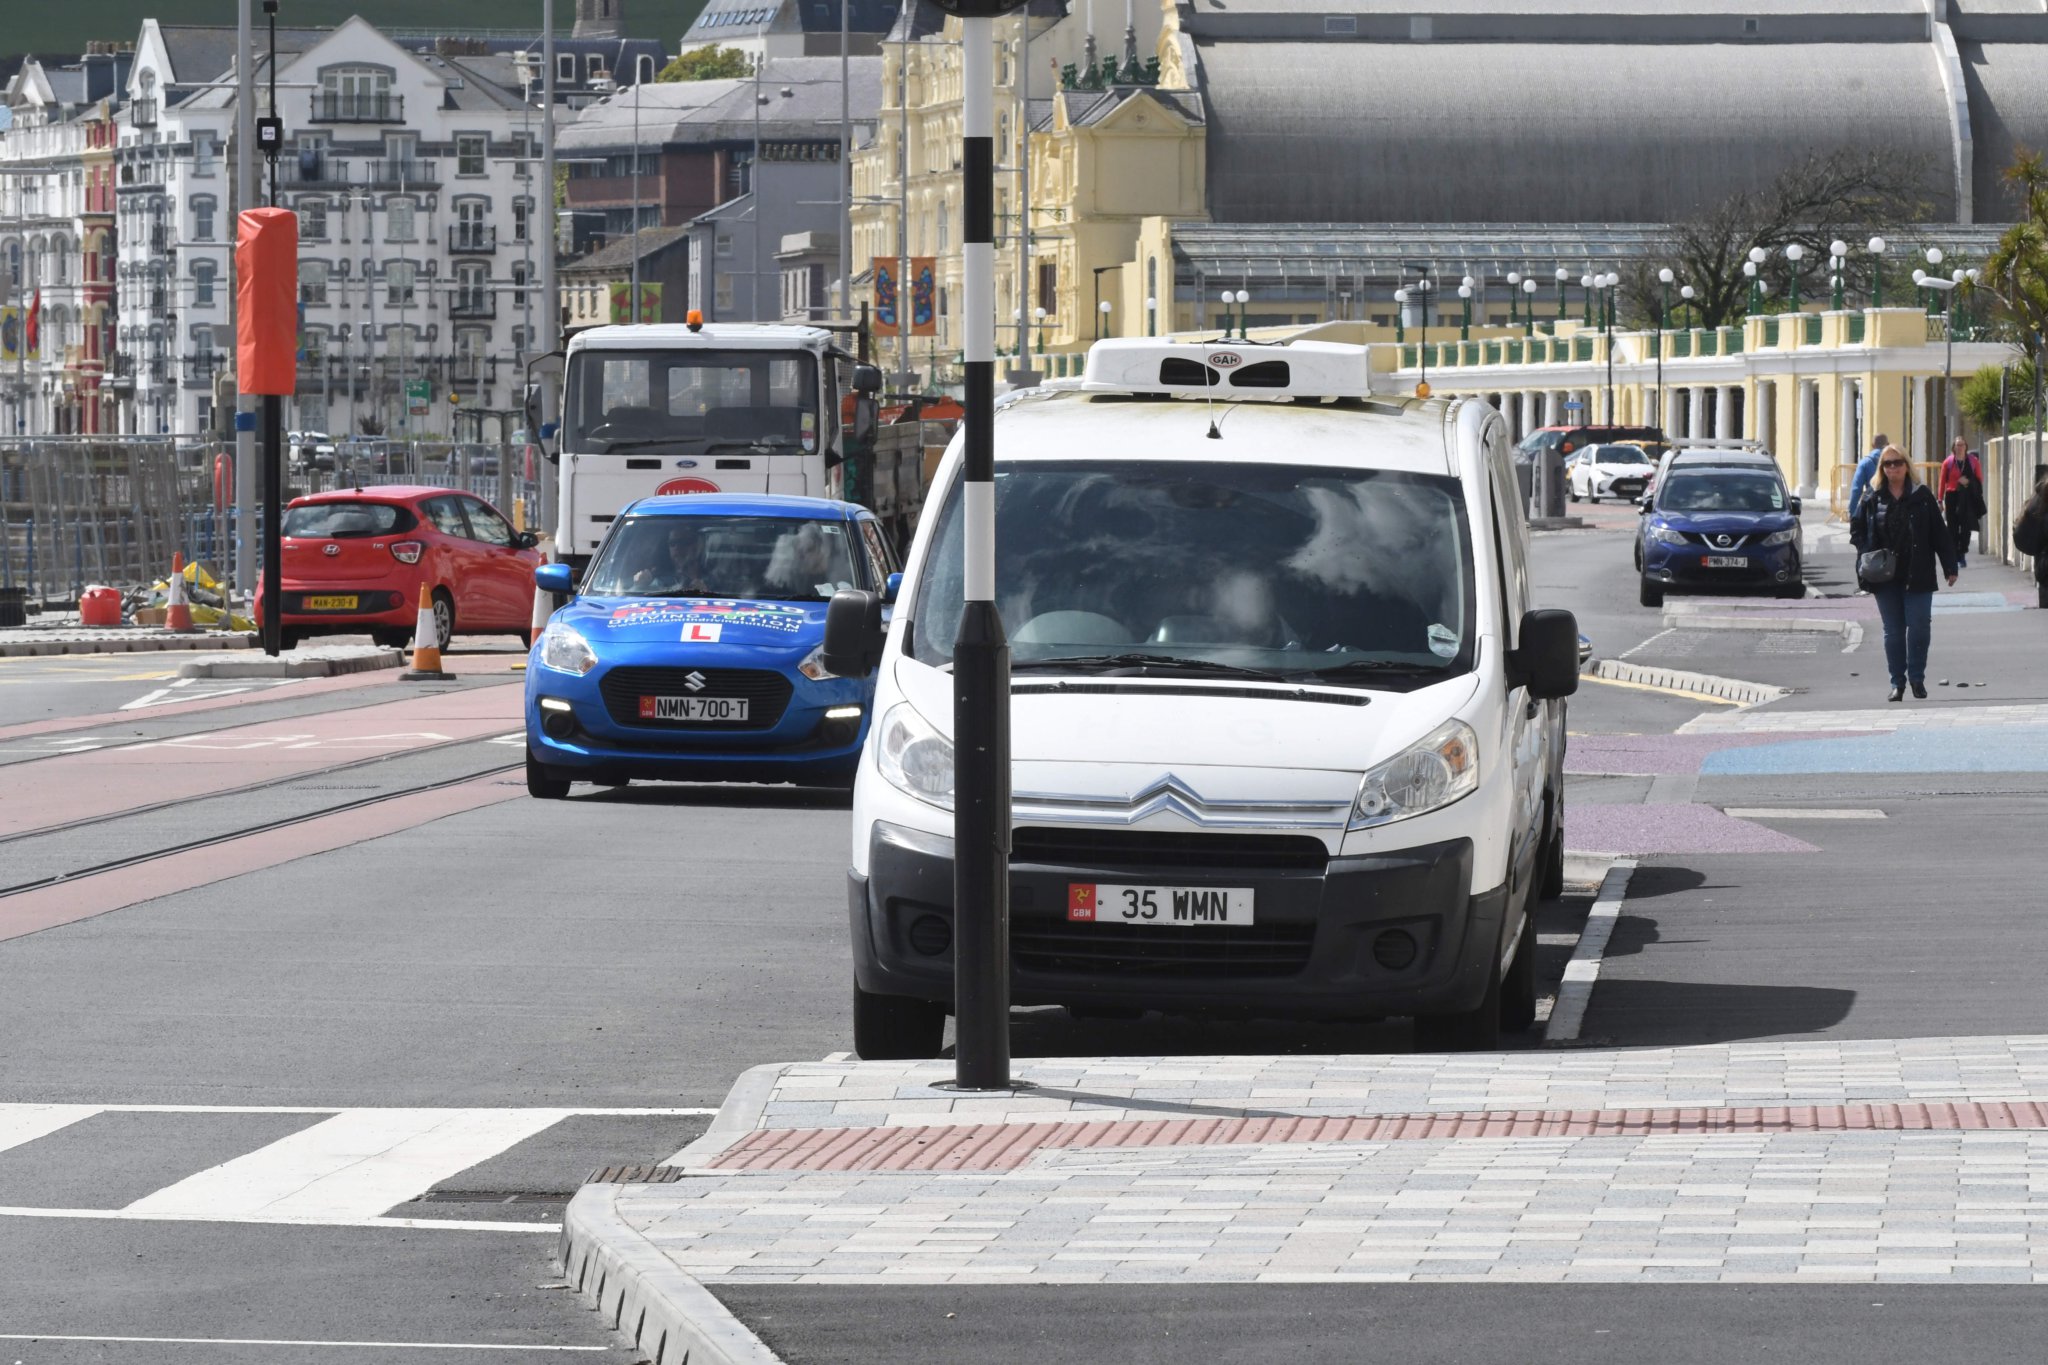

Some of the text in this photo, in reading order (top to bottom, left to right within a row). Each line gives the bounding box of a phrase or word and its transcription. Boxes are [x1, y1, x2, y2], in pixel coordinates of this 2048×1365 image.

[1212, 355, 1238, 365] GAH
[608, 613, 800, 630] DRIVING TUITION
[690, 624, 711, 640] L
[656, 698, 747, 718] NMN-700-T
[1121, 889, 1158, 920] 35
[1172, 890, 1228, 921] WMN
